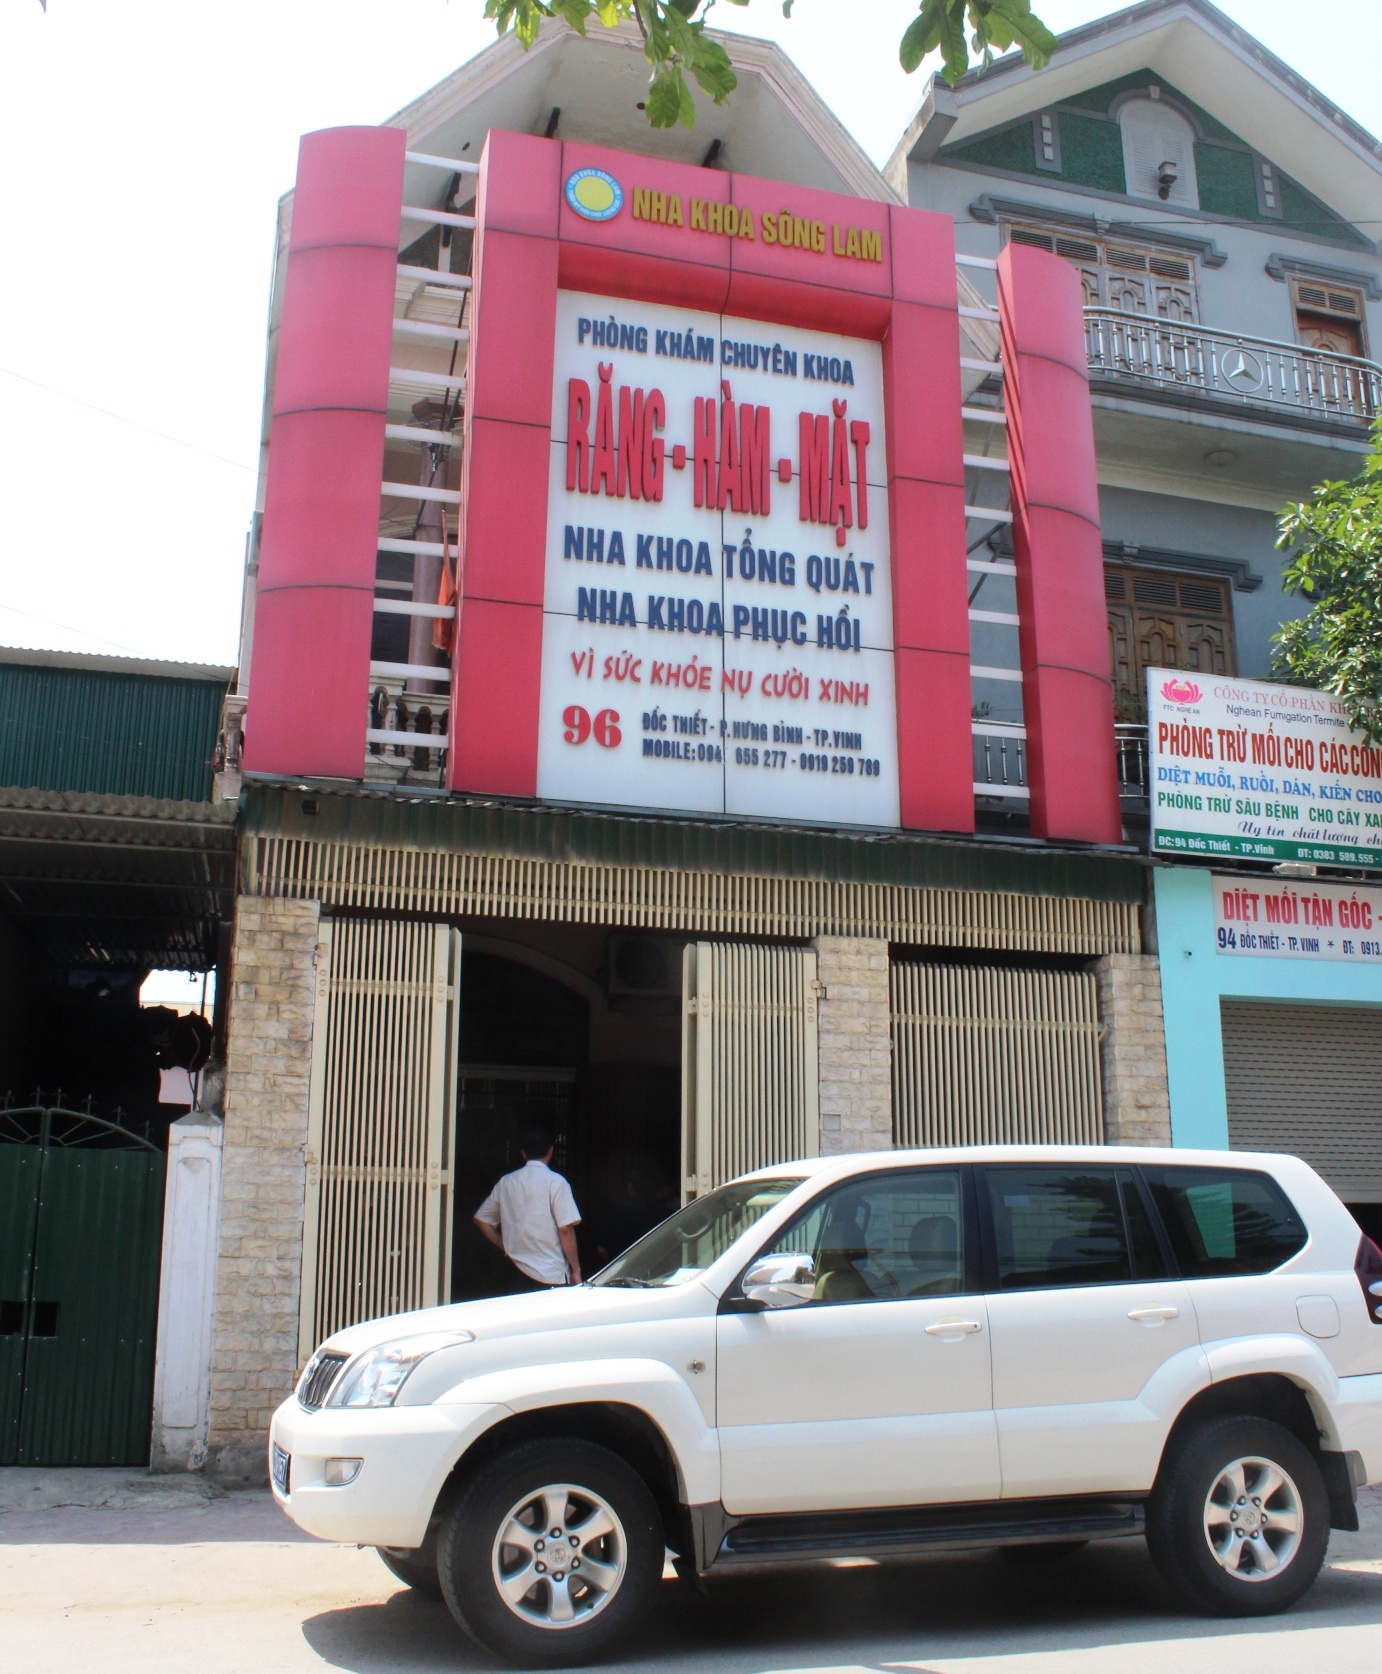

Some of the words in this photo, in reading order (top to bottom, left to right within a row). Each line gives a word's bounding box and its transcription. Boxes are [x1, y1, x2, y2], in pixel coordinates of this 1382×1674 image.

[632, 186, 684, 228] NHA
[690, 197, 755, 240] KHOA
[761, 208, 826, 253] SÔNG
[833, 223, 883, 263] LAM
[578, 315, 648, 354] PHÒNG
[655, 327, 715, 365] KHÁM
[720, 339, 797, 377] CHUYÊN
[803, 353, 855, 386] KHOA
[566, 361, 666, 502] RĂNG
[693, 379, 771, 517] HÀM
[799, 398, 870, 547] MẶT
[564, 525, 626, 566] NHA
[636, 534, 713, 576] KHOA
[722, 527, 796, 586] TỔNG
[806, 552, 875, 595] QUÁT
[577, 586, 637, 628] NHA
[648, 595, 724, 637] KHOA
[733, 604, 807, 650] PHỤC
[817, 604, 861, 653] HỒI
[570, 647, 595, 679] VÌ
[603, 649, 642, 683] SỨC
[650, 654, 713, 691] KHỎE
[721, 668, 752, 699] NỤ
[761, 667, 809, 700] CƯỜI
[819, 678, 870, 707] XINH
[1214, 685, 1250, 702] CÔNG
[1253, 692, 1269, 705] TY
[1270, 689, 1288, 707] CỔ
[1291, 694, 1325, 712] PHẦN
[1226, 704, 1262, 717] Nghean
[1264, 708, 1312, 724] Fumigation
[1313, 714, 1345, 727] Termite
[562, 705, 622, 748] 96
[642, 705, 667, 732] ĐỐC
[773, 719, 803, 745] BÌNH
[763, 750, 787, 769] 277
[1158, 717, 1214, 760] PHÒNG
[1217, 724, 1247, 763] TRỪ
[1251, 722, 1282, 767] MỐI
[1284, 736, 1315, 771] CHO
[1319, 736, 1349, 775] CÁC
[1157, 765, 1191, 787] DIỆT
[1195, 766, 1235, 791] MUỖI,
[1239, 770, 1279, 795] RUỒI,
[1319, 779, 1352, 801] KIẾN
[1355, 789, 1382, 804] CHO
[1157, 790, 1202, 811] PHÒNG
[1206, 794, 1232, 813] TRỪ
[1236, 797, 1261, 817] SÂU
[1265, 800, 1299, 822] BỆNH
[1309, 807, 1333, 823] CHO
[1337, 808, 1361, 826] CÂY
[1364, 812, 1382, 828] XA
[1237, 820, 1261, 837] Uy
[1188, 837, 1206, 850] Đốc
[1208, 839, 1231, 852] Thiết
[1297, 847, 1312, 859] ĐT:
[1313, 849, 1335, 860] 0383
[1222, 887, 1260, 927] DIỆT
[1264, 885, 1299, 925] MỐI
[1300, 892, 1334, 931] TẬN
[1338, 891, 1373, 930] GỐC
[1217, 927, 1236, 949] 94
[1240, 929, 1257, 949] ĐỐC
[1258, 930, 1279, 950] THIẾT
[1342, 940, 1354, 954] ĐT:
